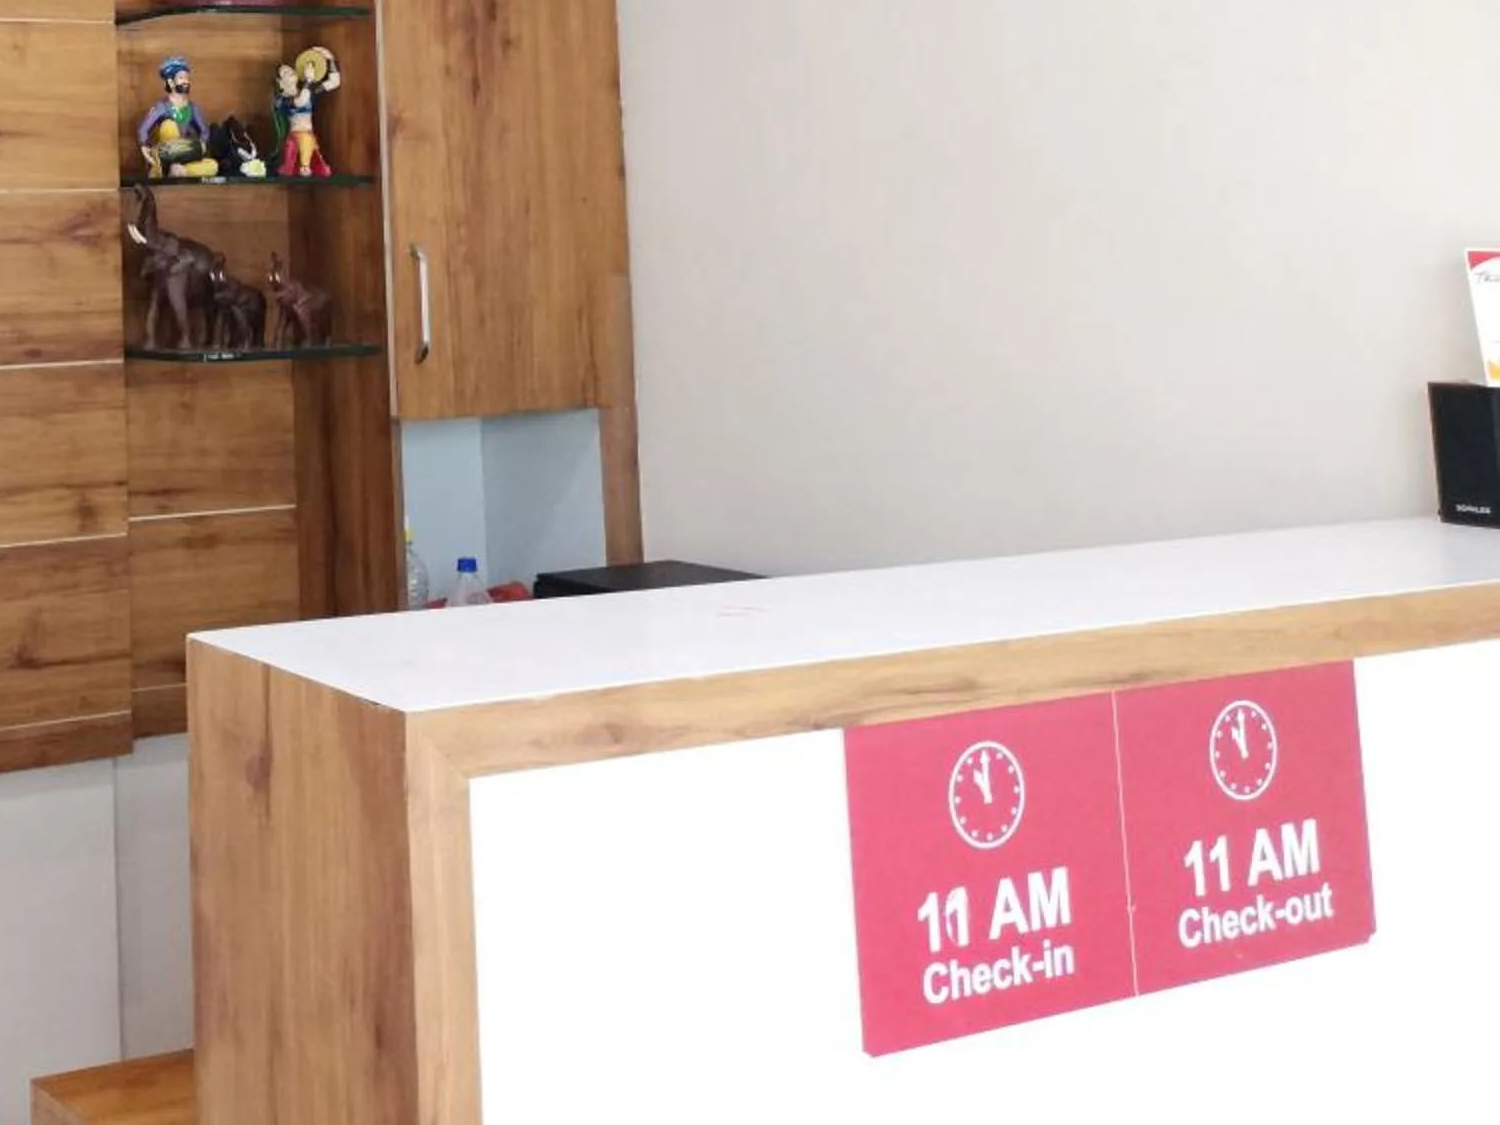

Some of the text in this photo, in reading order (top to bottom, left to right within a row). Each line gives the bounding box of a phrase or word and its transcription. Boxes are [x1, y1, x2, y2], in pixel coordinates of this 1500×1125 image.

[1184, 818, 1321, 898] 11 AM
[988, 865, 1072, 940] AM
[1178, 881, 1335, 949] Check-out
[922, 938, 1076, 1005] Check-in
